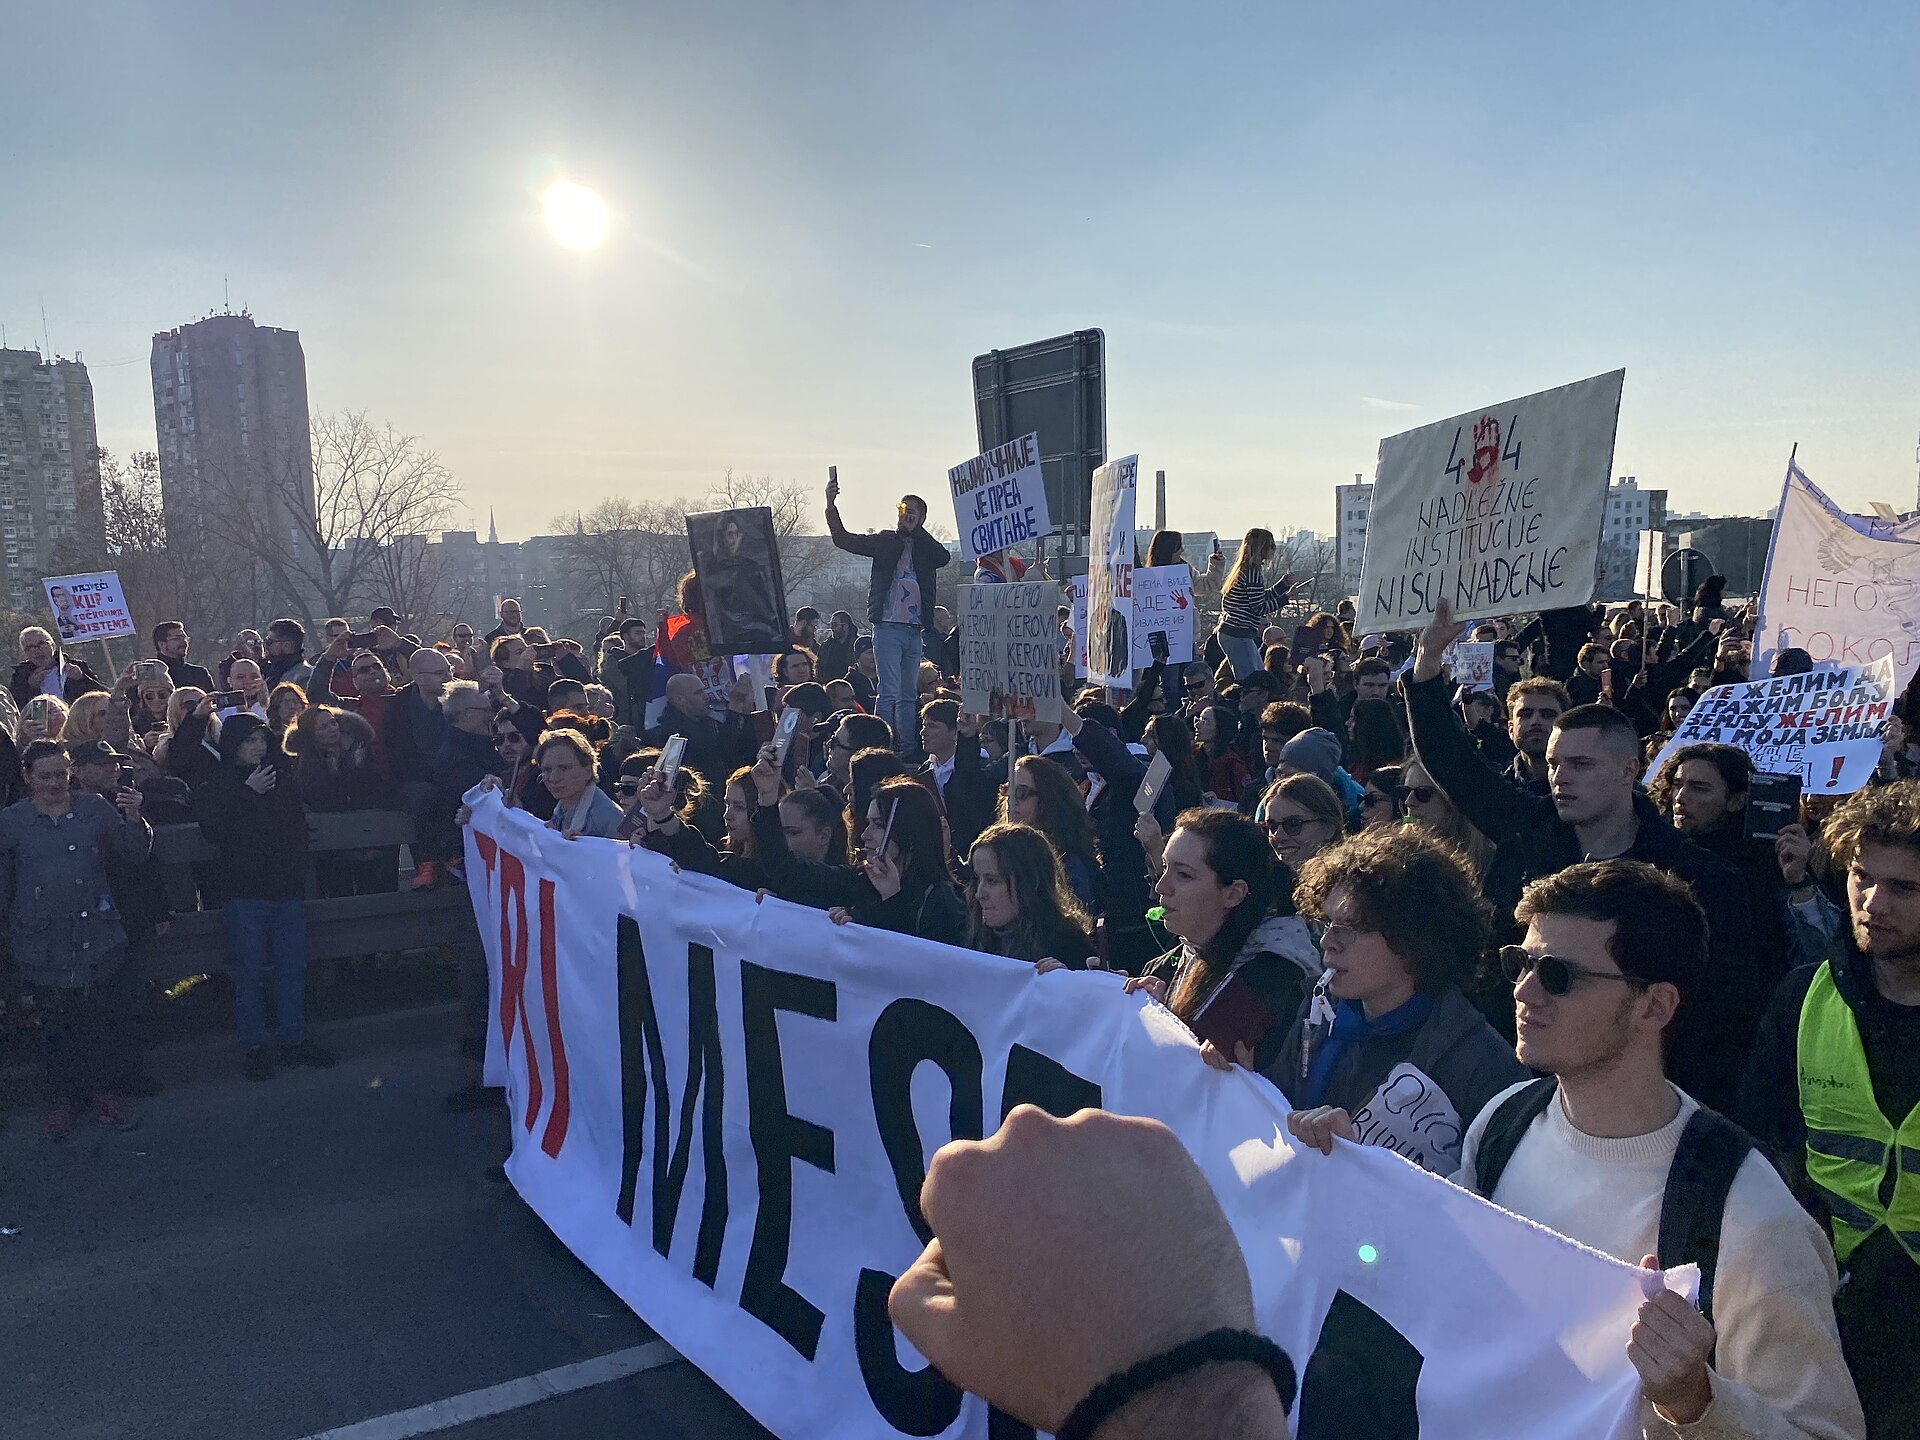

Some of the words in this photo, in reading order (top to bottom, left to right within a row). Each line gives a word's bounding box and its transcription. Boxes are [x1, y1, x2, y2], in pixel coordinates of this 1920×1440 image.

[1444, 414, 1522, 485] 404
[989, 478, 1022, 515] ПРЕД
[1417, 477, 1539, 531] NADLEŽNE
[971, 506, 1039, 556] СВИТАЊЕ
[1405, 513, 1543, 569] INSTITUCIJE
[1375, 569, 1444, 617] NISU
[1456, 546, 1568, 610] NAĐENE
[71, 592, 102, 609] KLIP
[73, 609, 124, 621] TOČKOVIMA
[80, 618, 130, 634] SISTEMA
[1006, 614, 1057, 638] KEROVI
[1006, 642, 1057, 669] KEROVI
[1007, 670, 1057, 699] KEROVI
[1741, 670, 1848, 699] ЖЕЛИМ
[1854, 660, 1893, 686] ДА
[1686, 712, 1774, 729] ЗЕМЉУ
[1774, 701, 1889, 729] ЖЕЛИМ
[1697, 694, 1799, 715] ТРАЖИМ
[1810, 681, 1891, 710] БОЉУ
[1681, 725, 1722, 742] ДА
[1731, 726, 1806, 746] МОЈА
[474, 829, 569, 1159] TRI
